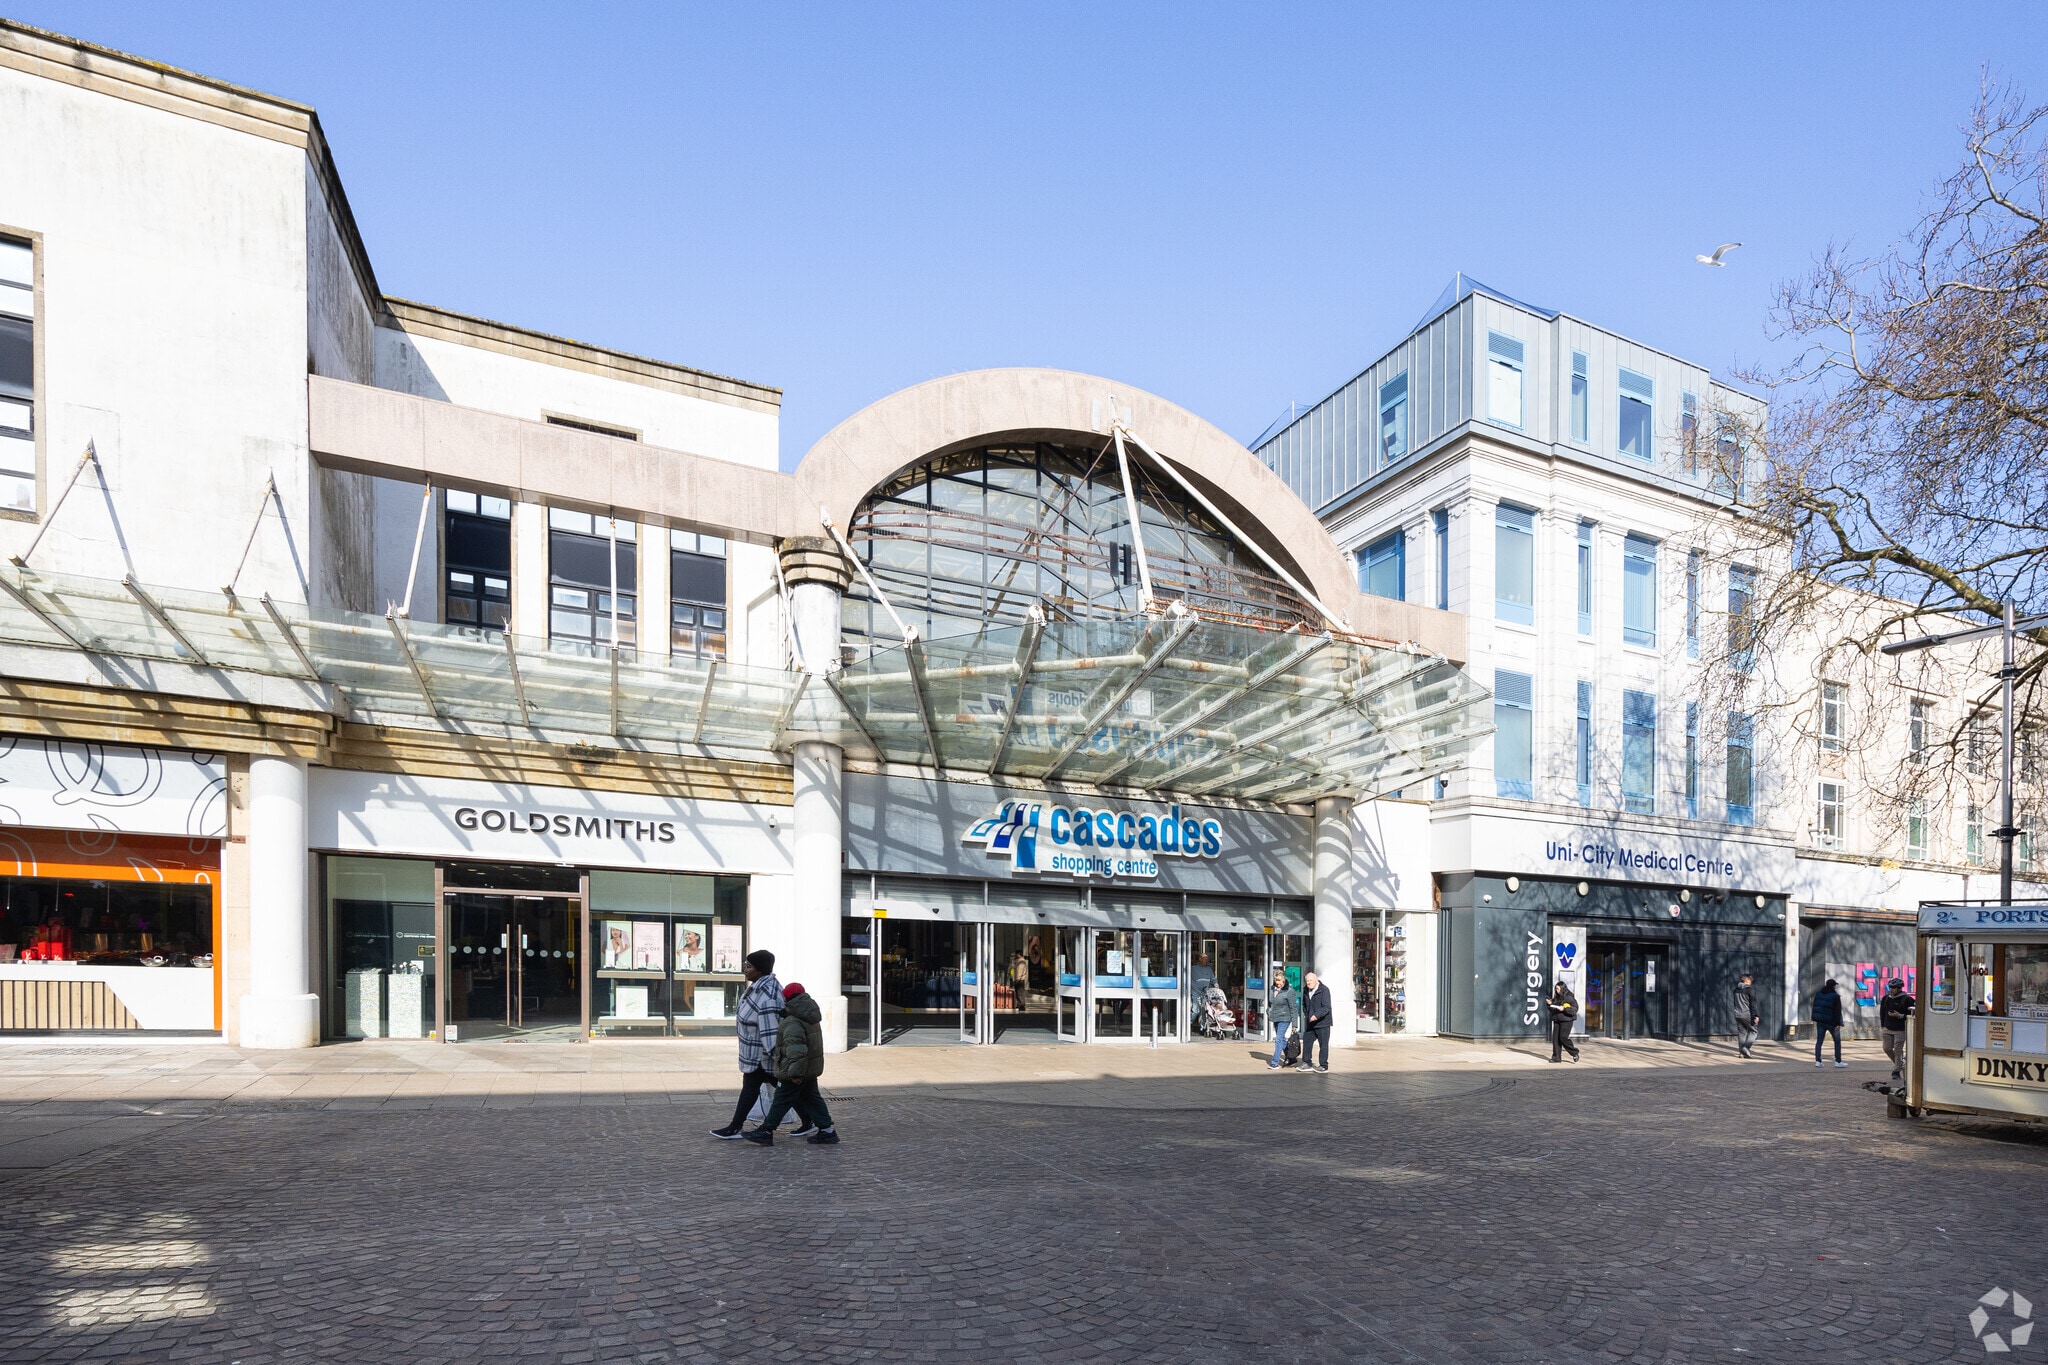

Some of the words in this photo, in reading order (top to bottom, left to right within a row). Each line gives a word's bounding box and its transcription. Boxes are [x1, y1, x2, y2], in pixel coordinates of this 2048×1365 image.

[454, 807, 676, 843] GOLDSMITHS
[1051, 805, 1220, 856] cascades
[1052, 853, 1113, 876] shopping
[1117, 858, 1157, 875] centre
[1619, 848, 1682, 871] Medical
[1685, 854, 1734, 876] Centre
[1976, 910, 2048, 924] PORTS
[1524, 931, 1543, 1026] Surgery
[1977, 1057, 2048, 1083] DINKY
